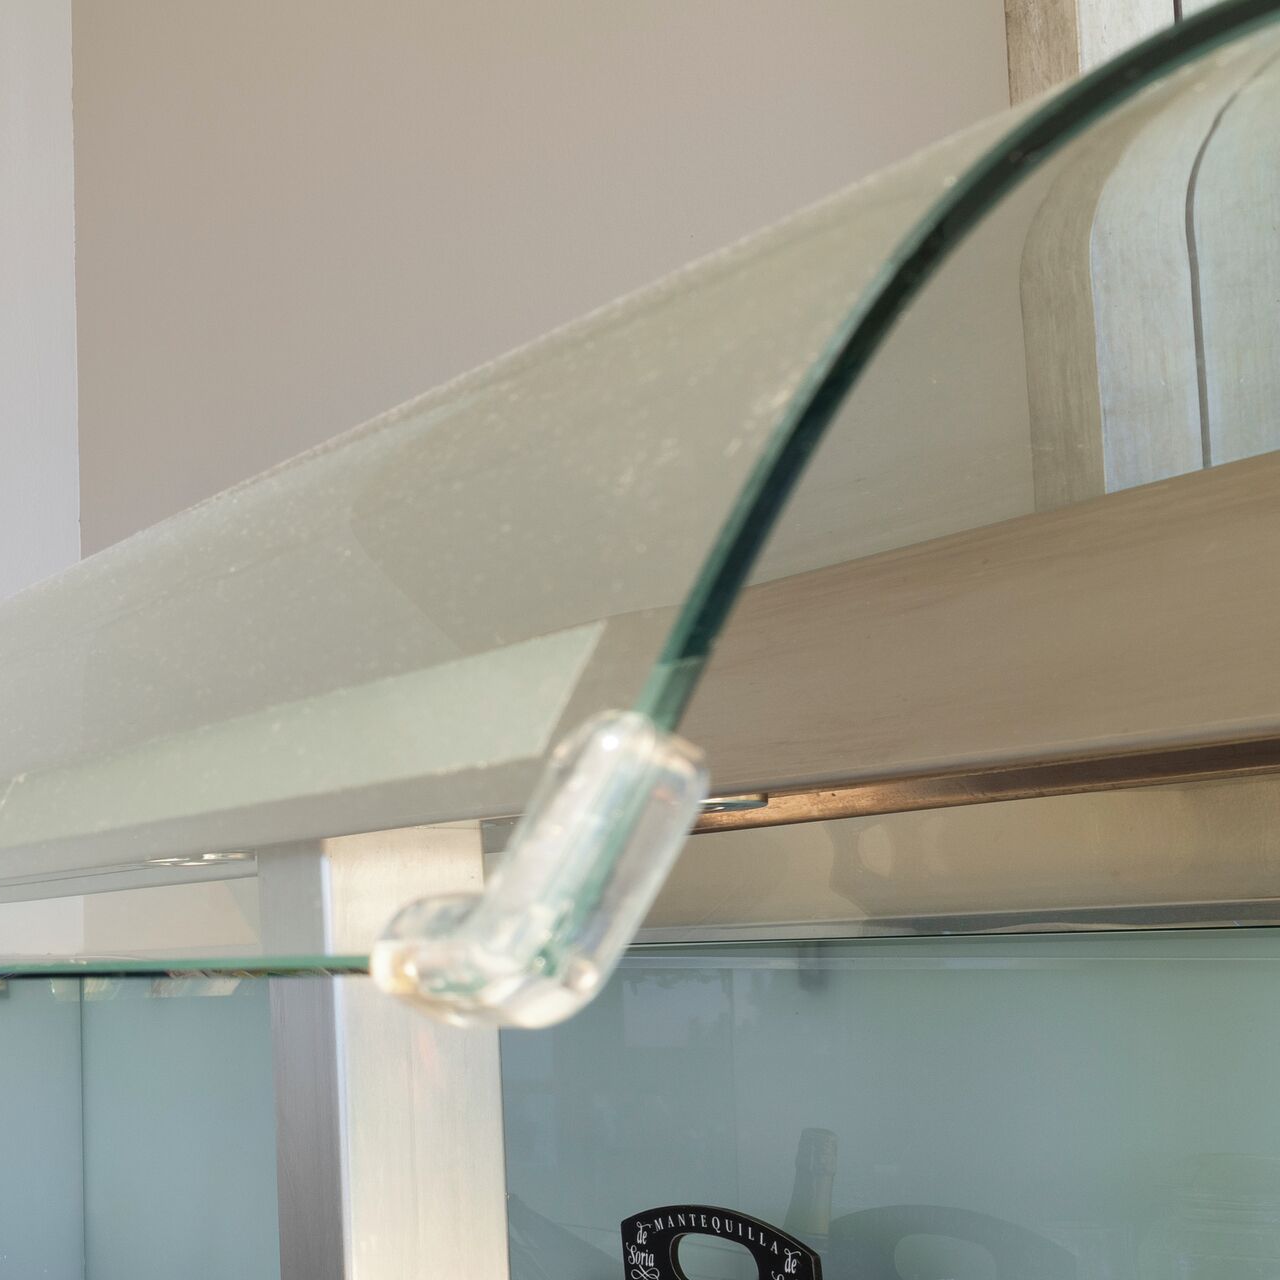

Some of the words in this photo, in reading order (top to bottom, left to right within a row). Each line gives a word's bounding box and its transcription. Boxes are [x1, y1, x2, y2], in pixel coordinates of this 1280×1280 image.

[636, 1221, 651, 1245] de
[653, 1213, 778, 1254] MANTEQUILLA
[626, 1242, 655, 1267] Soria
[784, 1248, 801, 1274] de
